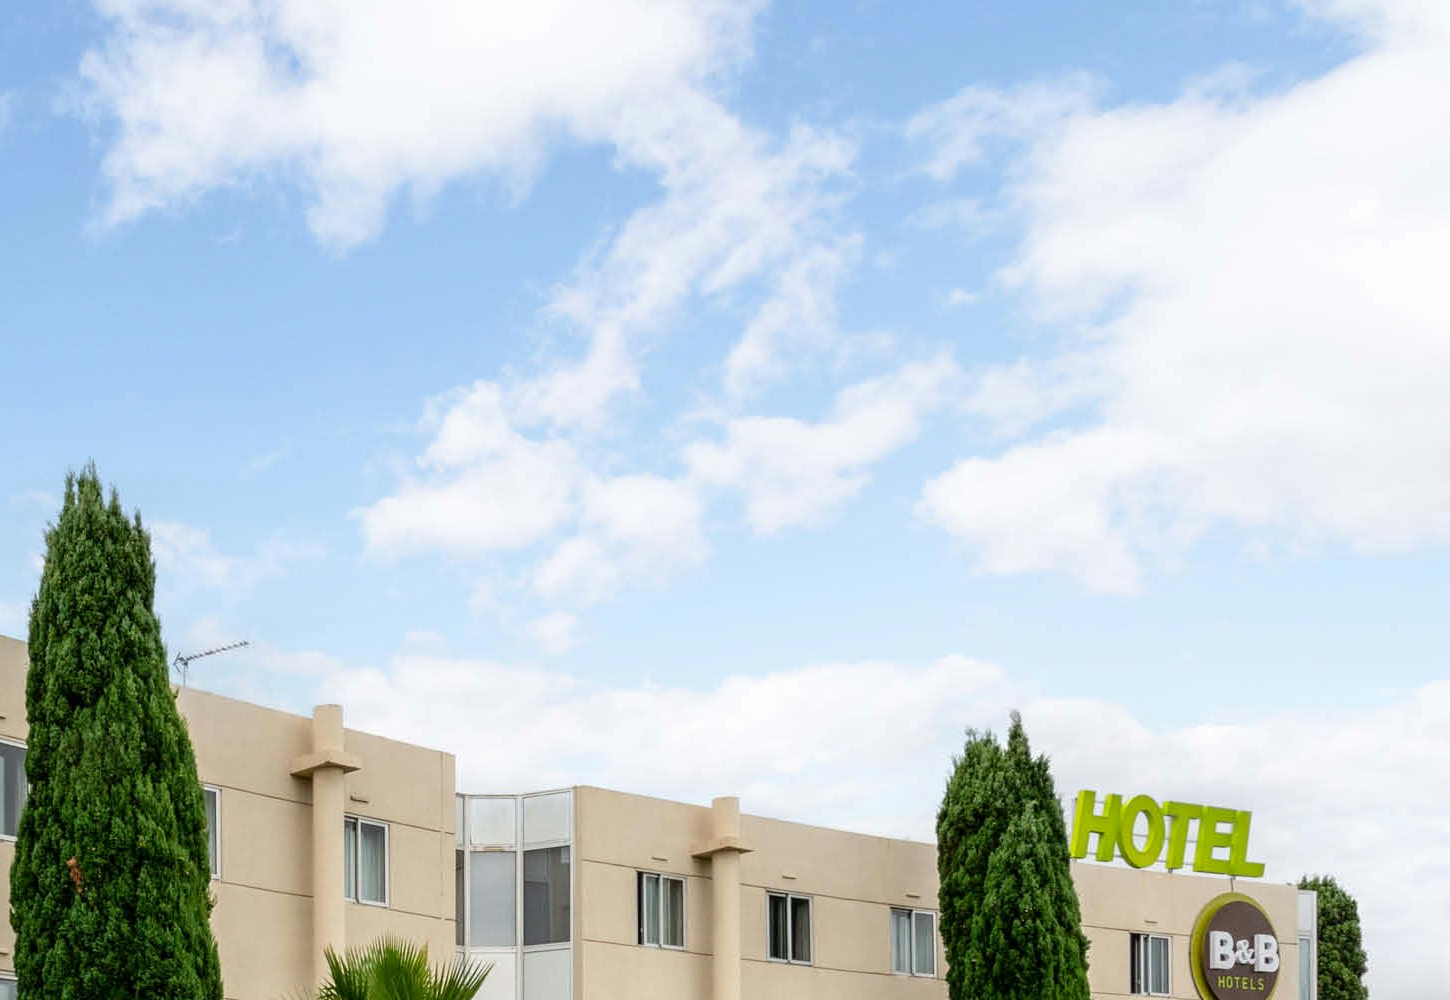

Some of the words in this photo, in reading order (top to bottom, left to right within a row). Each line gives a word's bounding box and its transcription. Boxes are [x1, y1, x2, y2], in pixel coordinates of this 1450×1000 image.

[1070, 789, 1266, 878] HOTEL
[1209, 930, 1280, 973] B&B
[1217, 975, 1265, 991] HOTELS
